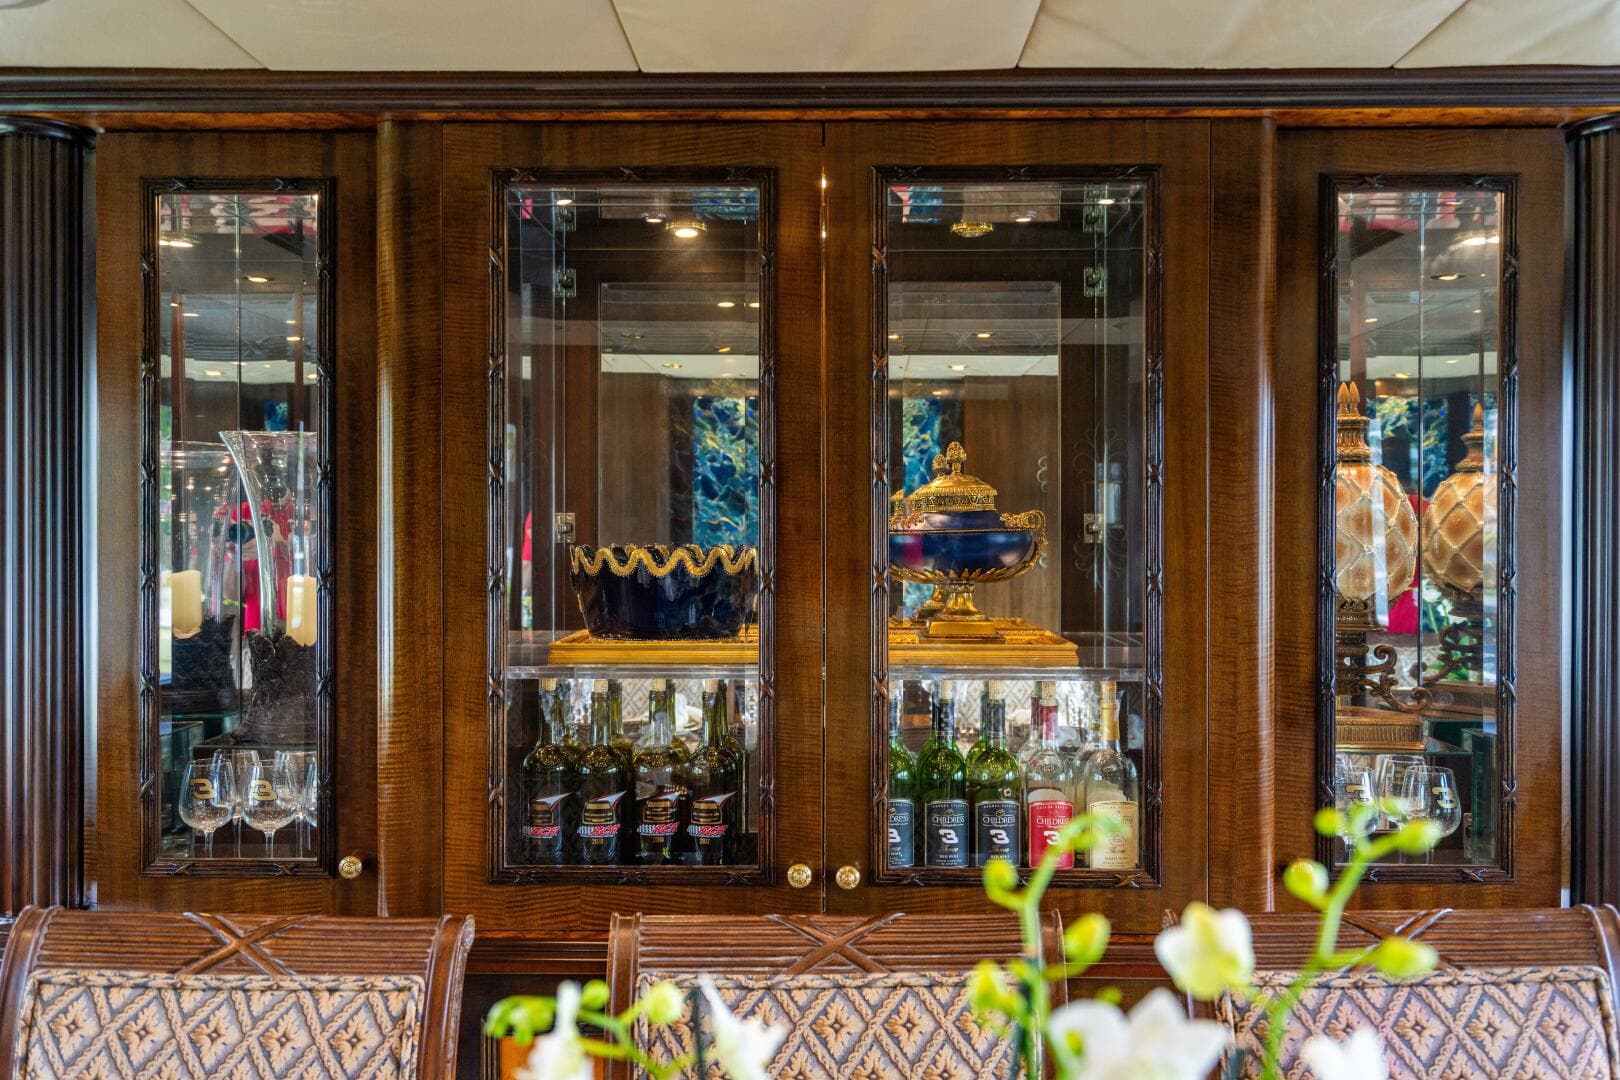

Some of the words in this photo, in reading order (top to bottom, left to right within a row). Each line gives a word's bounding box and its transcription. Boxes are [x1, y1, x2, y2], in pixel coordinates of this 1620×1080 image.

[189, 778, 217, 799] 3
[251, 779, 278, 801] 3
[1344, 784, 1373, 807] 3
[1431, 786, 1457, 808] 3
[932, 815, 965, 824] CHILDRESS
[982, 816, 1016, 824] CHILDRESS
[939, 829, 959, 844] 3
[989, 829, 1010, 845] 3
[1043, 830, 1062, 845] 3
